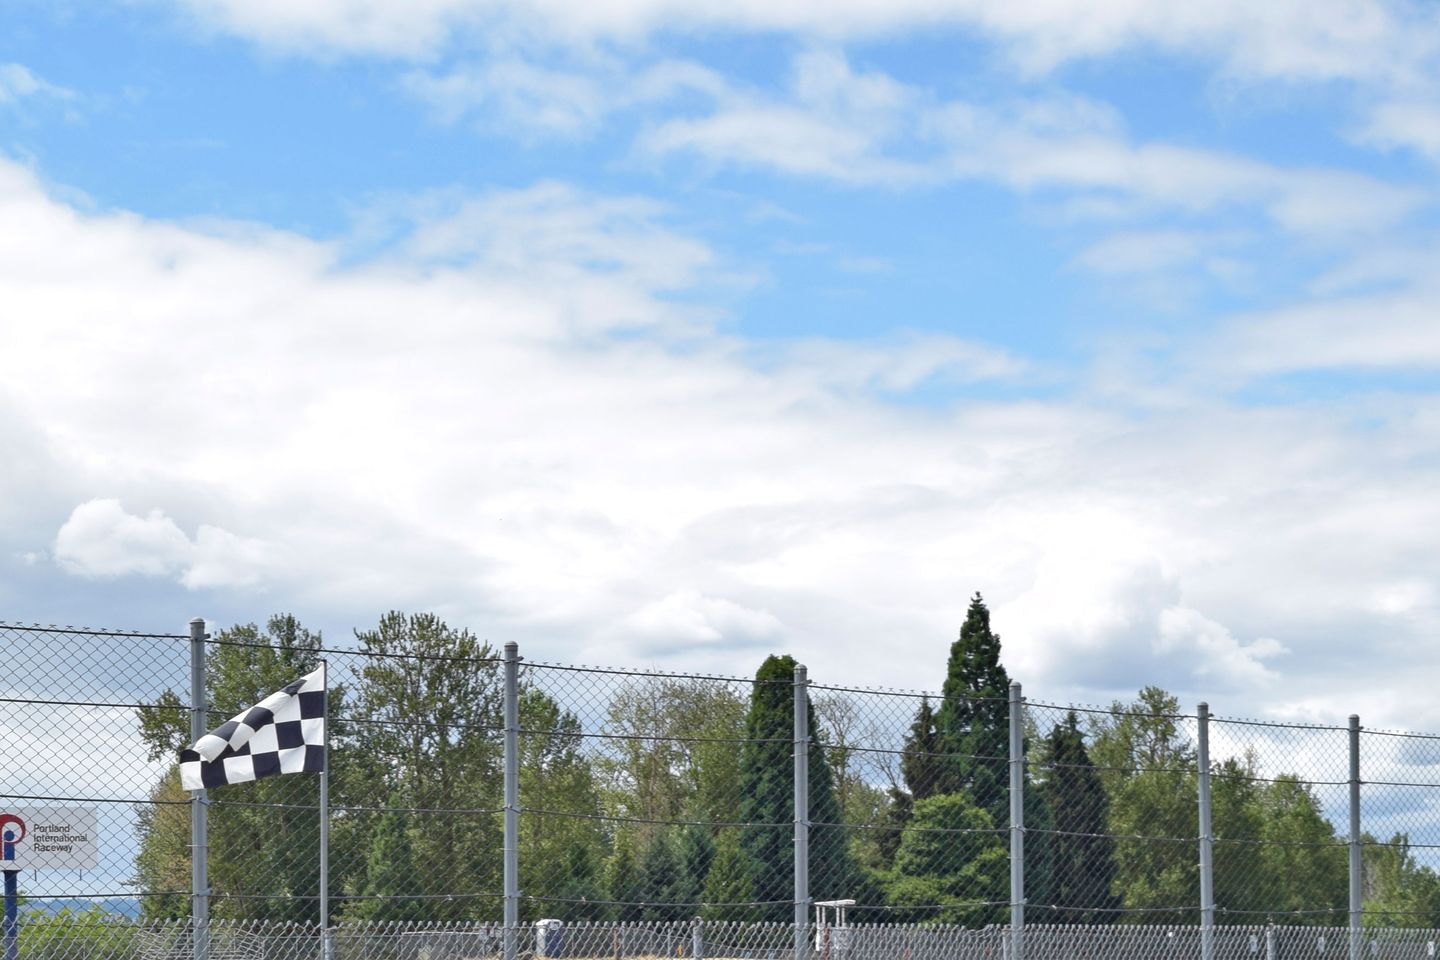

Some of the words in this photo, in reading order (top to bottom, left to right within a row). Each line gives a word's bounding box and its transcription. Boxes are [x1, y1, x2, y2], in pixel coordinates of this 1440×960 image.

[33, 824, 70, 832] Portland
[33, 833, 87, 842] International
[33, 843, 73, 853] Raceway
